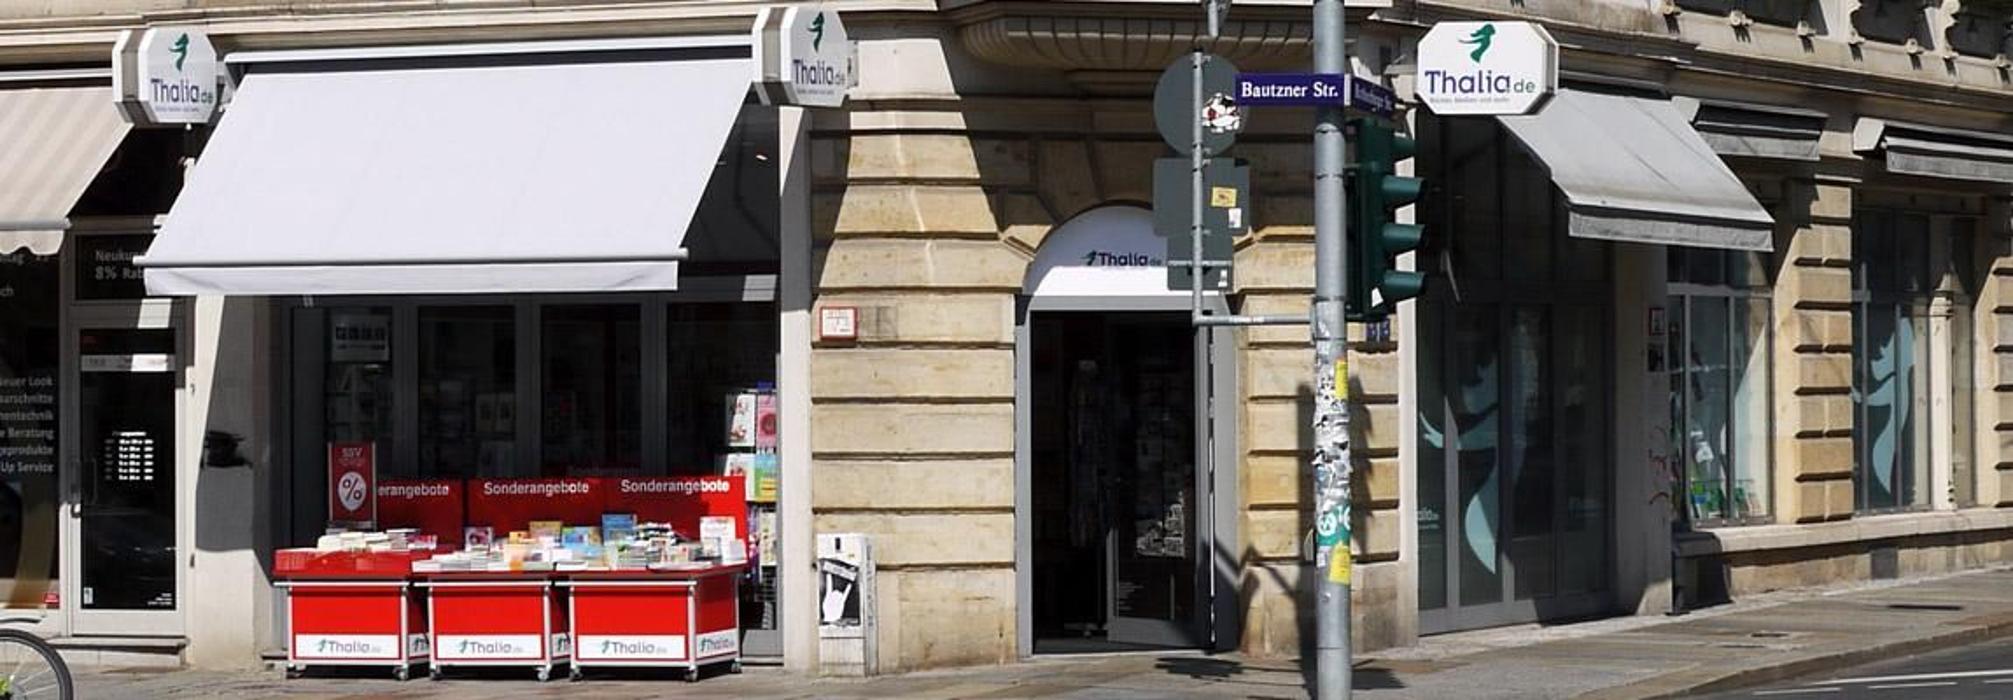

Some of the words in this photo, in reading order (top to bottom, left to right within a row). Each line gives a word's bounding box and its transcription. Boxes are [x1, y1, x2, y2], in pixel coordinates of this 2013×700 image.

[1241, 81, 1308, 97] Bautzner
[1313, 81, 1338, 97] Str.
[96, 266, 117, 280] 8%
[8, 427, 54, 441] Beratung
[17, 461, 54, 472] Service
[378, 483, 449, 499] erangebote
[484, 482, 589, 497] Sonderangebote
[621, 479, 730, 495] Sonderangebote
